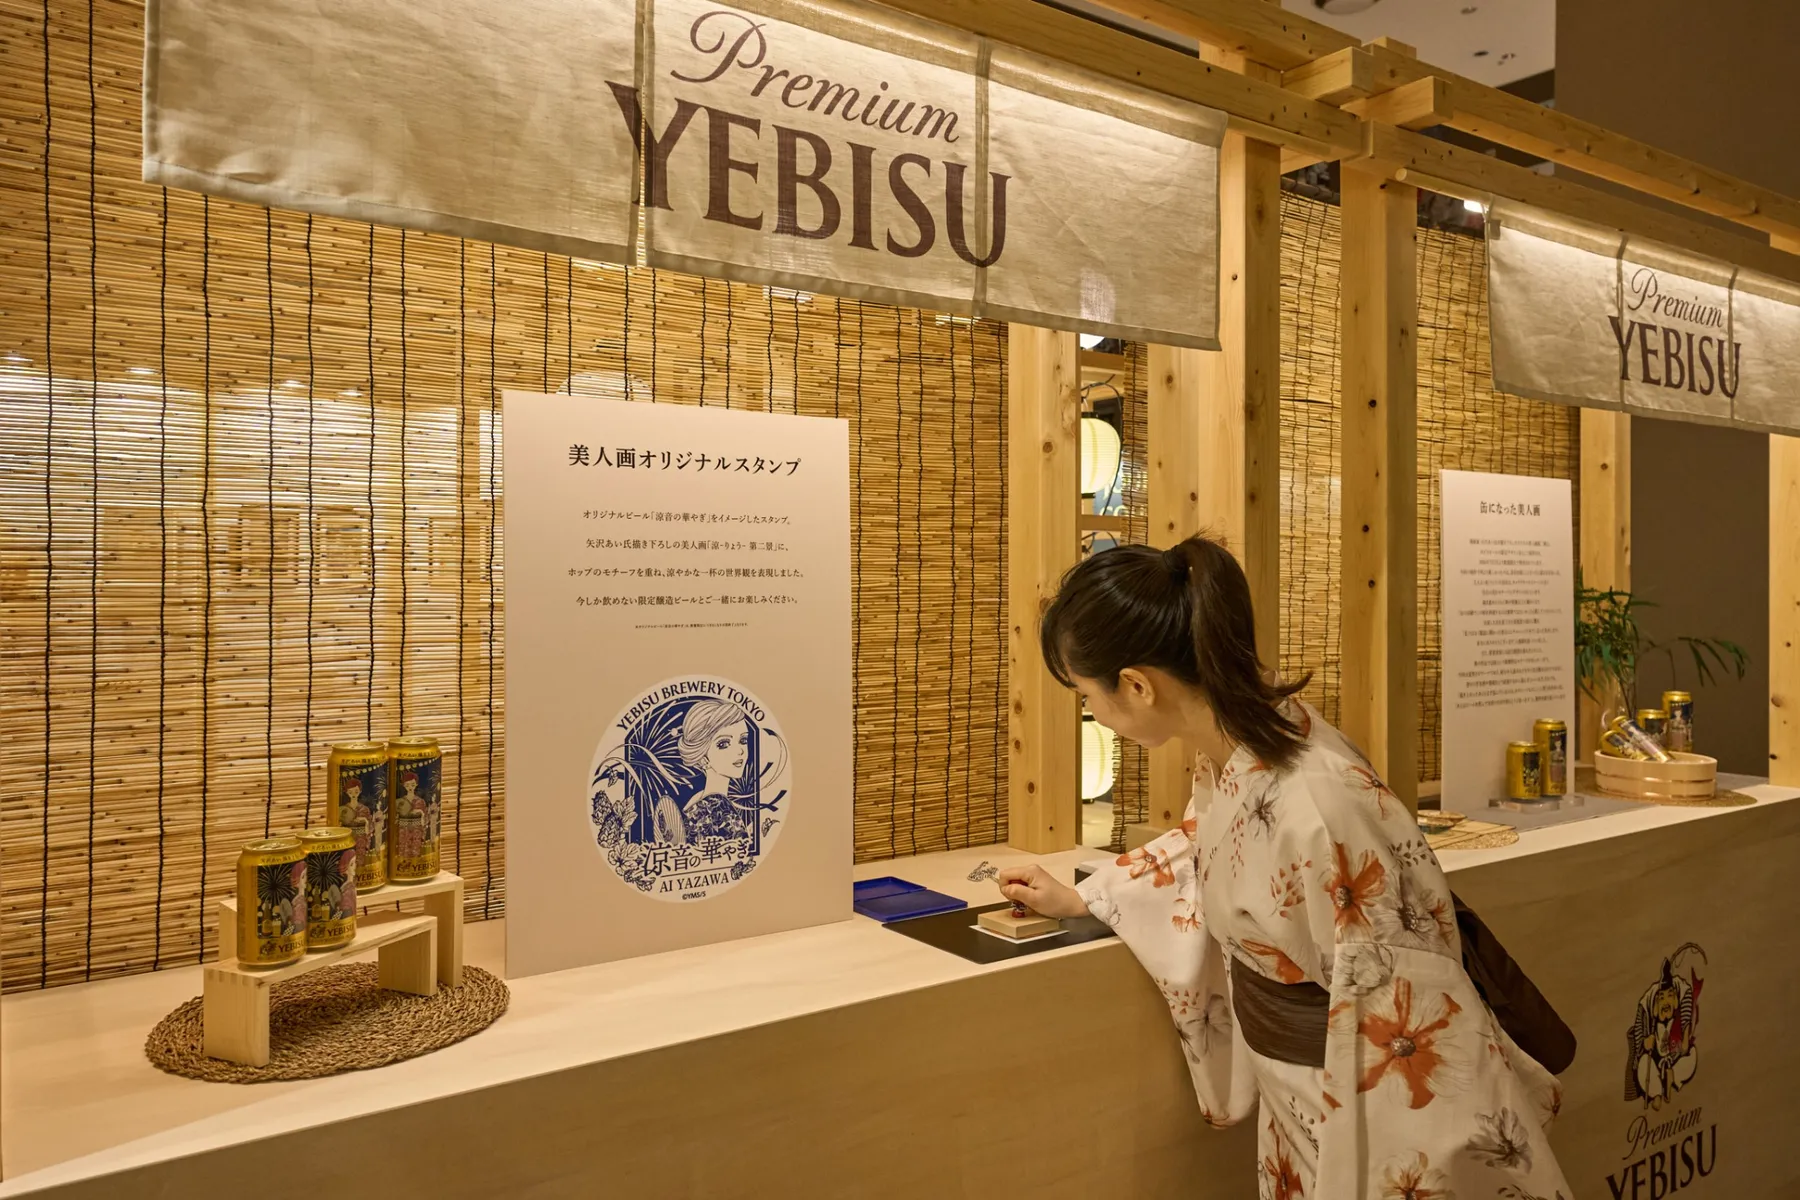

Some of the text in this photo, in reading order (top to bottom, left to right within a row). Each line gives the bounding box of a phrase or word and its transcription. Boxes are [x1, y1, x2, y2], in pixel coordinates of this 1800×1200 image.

[670, 11, 959, 143] Premium
[604, 81, 1012, 268] YEBISU
[1627, 268, 1723, 328] Premium
[1608, 315, 1742, 399] YEBISU
[568, 444, 802, 476] 美人画オリジナルスタンプ
[1480, 501, 1540, 516] 缶になった美人画
[616, 680, 766, 731] YEBISU BREWERY TOKYO
[640, 838, 750, 877] 涼音の華やぎ
[660, 872, 729, 893] AI YAZAWA
[1622, 1106, 1702, 1160] Premium
[1606, 1124, 1717, 1200] YEBISU
